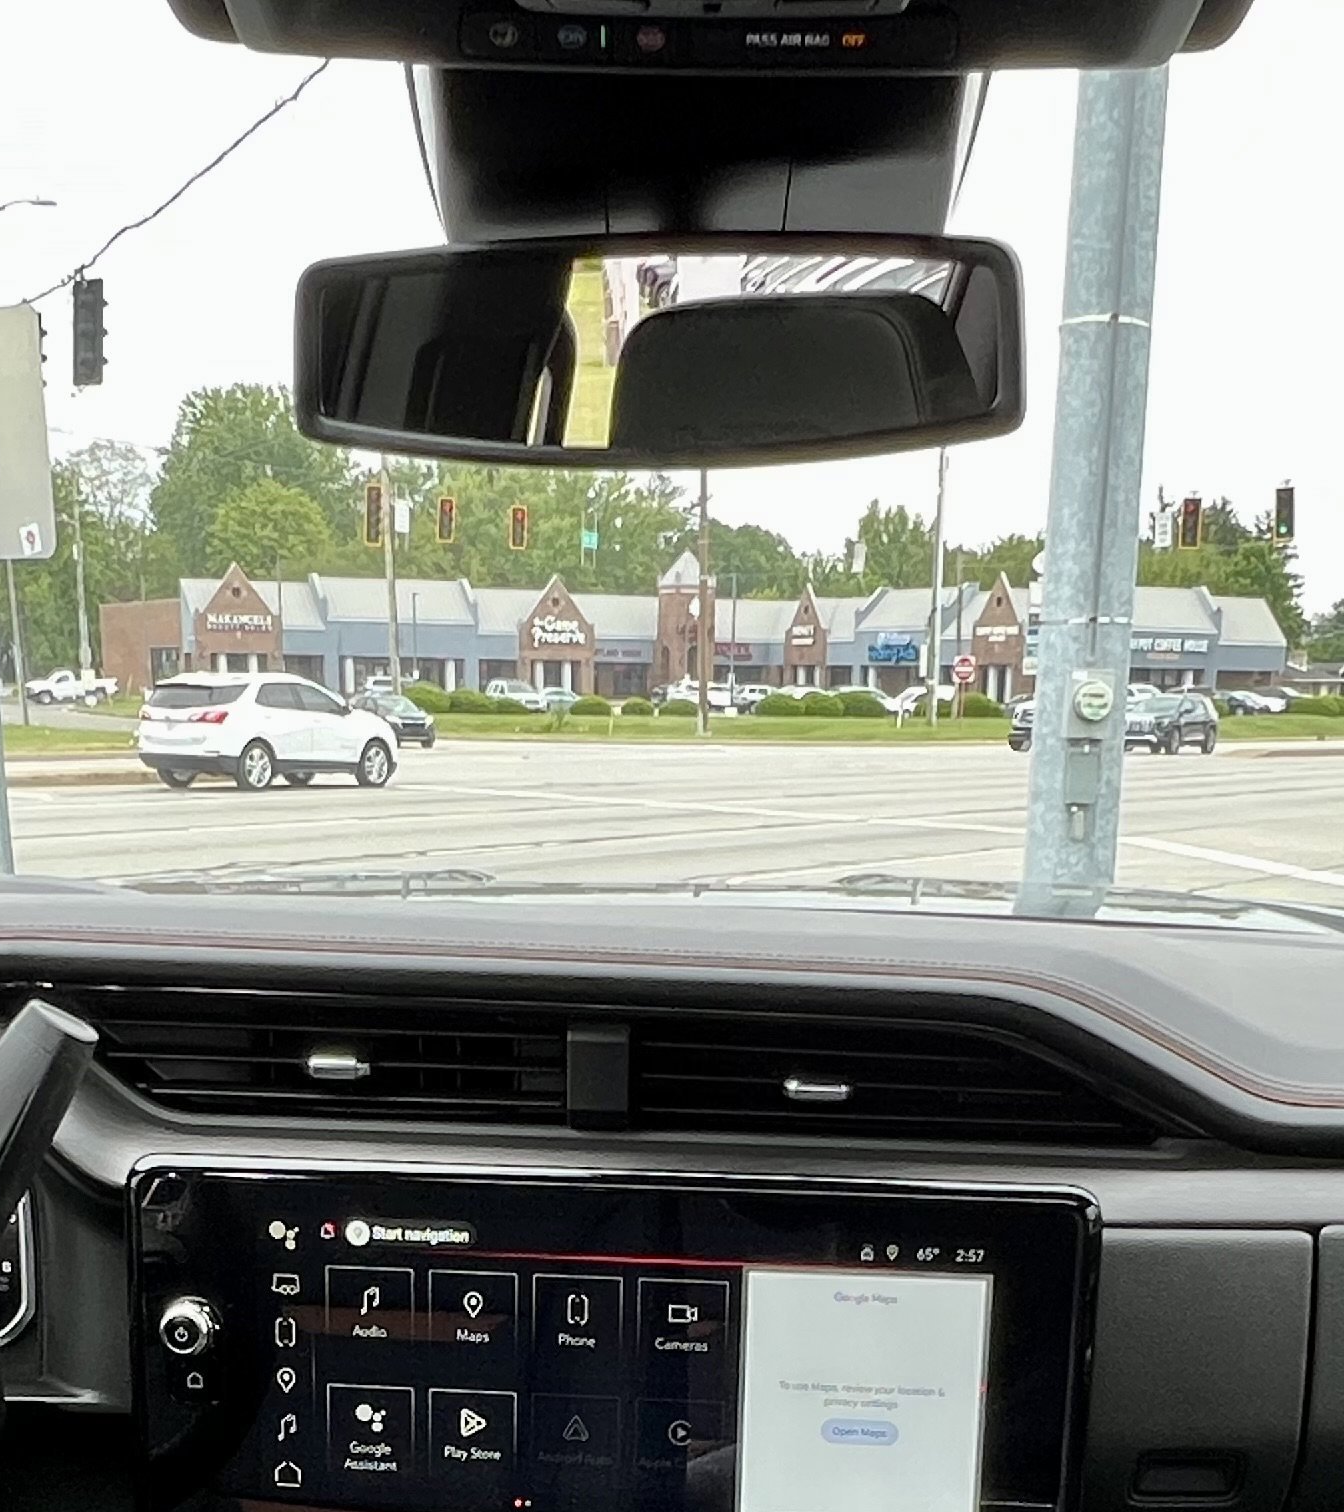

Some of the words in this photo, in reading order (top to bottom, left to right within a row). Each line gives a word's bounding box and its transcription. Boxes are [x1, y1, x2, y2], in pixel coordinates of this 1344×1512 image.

[746, 33, 777, 47] PASS
[780, 33, 802, 47] AIR
[804, 34, 830, 48] BAG
[842, 34, 866, 48] OFF
[544, 615, 580, 632] Game
[531, 627, 586, 648] Preserve
[372, 1225, 403, 1241] Start
[405, 1226, 470, 1246] navigation
[955, 1248, 985, 1263] 2:57
[834, 1291, 870, 1305] Google
[872, 1293, 898, 1305] Maps
[352, 1324, 388, 1338] Audio
[456, 1328, 490, 1344] Maps
[558, 1332, 596, 1348] Phone
[655, 1336, 709, 1352] Cameras
[779, 1381, 791, 1391] To
[842, 1385, 873, 1395] review
[874, 1386, 896, 1396] your
[897, 1386, 936, 1397] location
[823, 1398, 858, 1409] privacy
[860, 1400, 899, 1411] settings
[832, 1427, 859, 1438] Open
[861, 1428, 888, 1440] Maps
[349, 1441, 392, 1457] Google
[444, 1445, 468, 1462] Play
[470, 1446, 502, 1461] Store
[344, 1458, 398, 1472] Assistant
